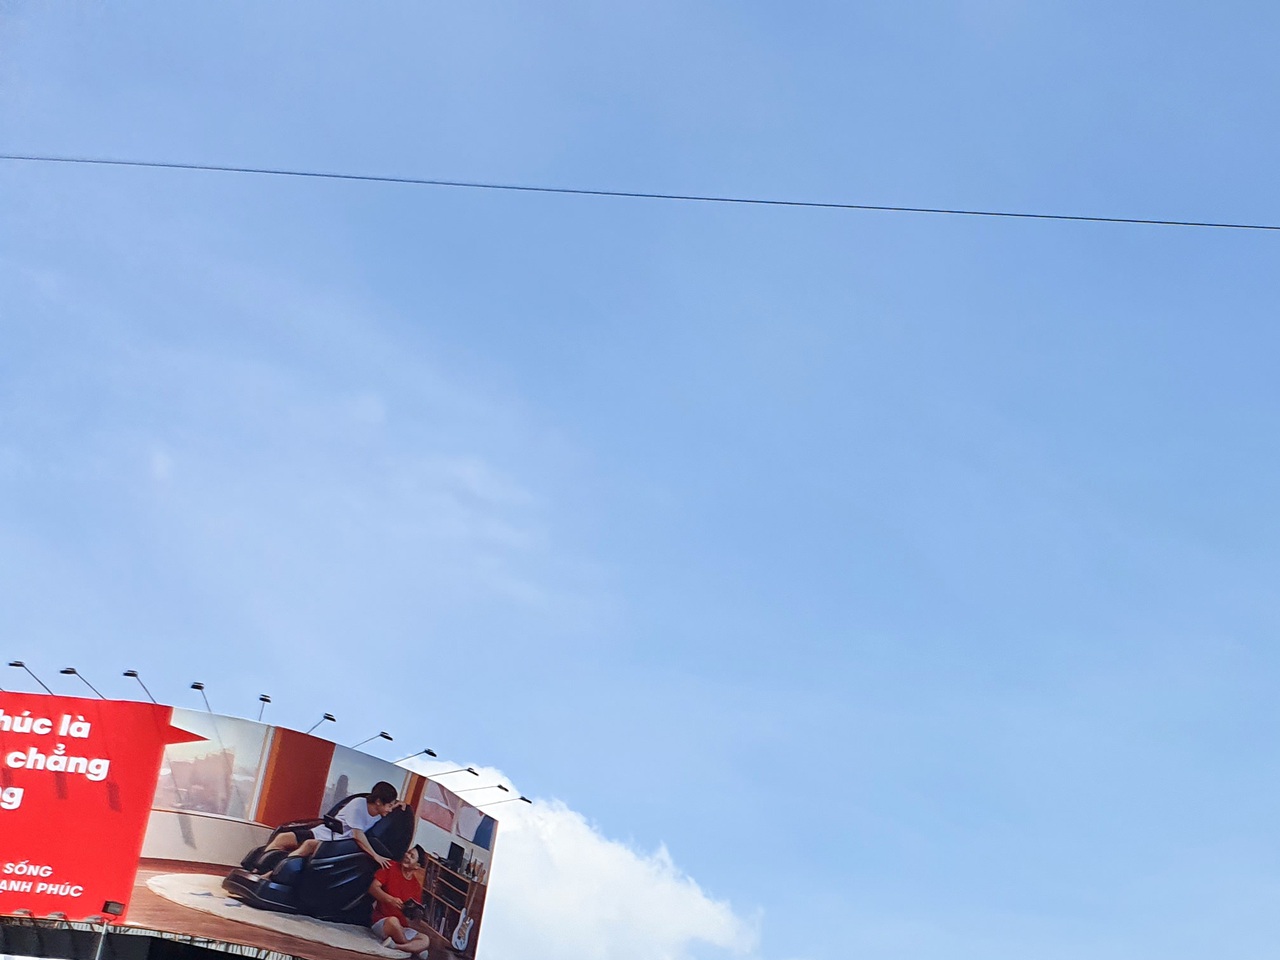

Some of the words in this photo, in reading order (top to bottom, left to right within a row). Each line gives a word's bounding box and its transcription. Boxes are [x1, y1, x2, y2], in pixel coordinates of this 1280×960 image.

[59, 714, 91, 738] là
[6, 743, 110, 781] chẳng
[3, 860, 53, 877] SỐNG
[35, 881, 84, 897] PHÚC
